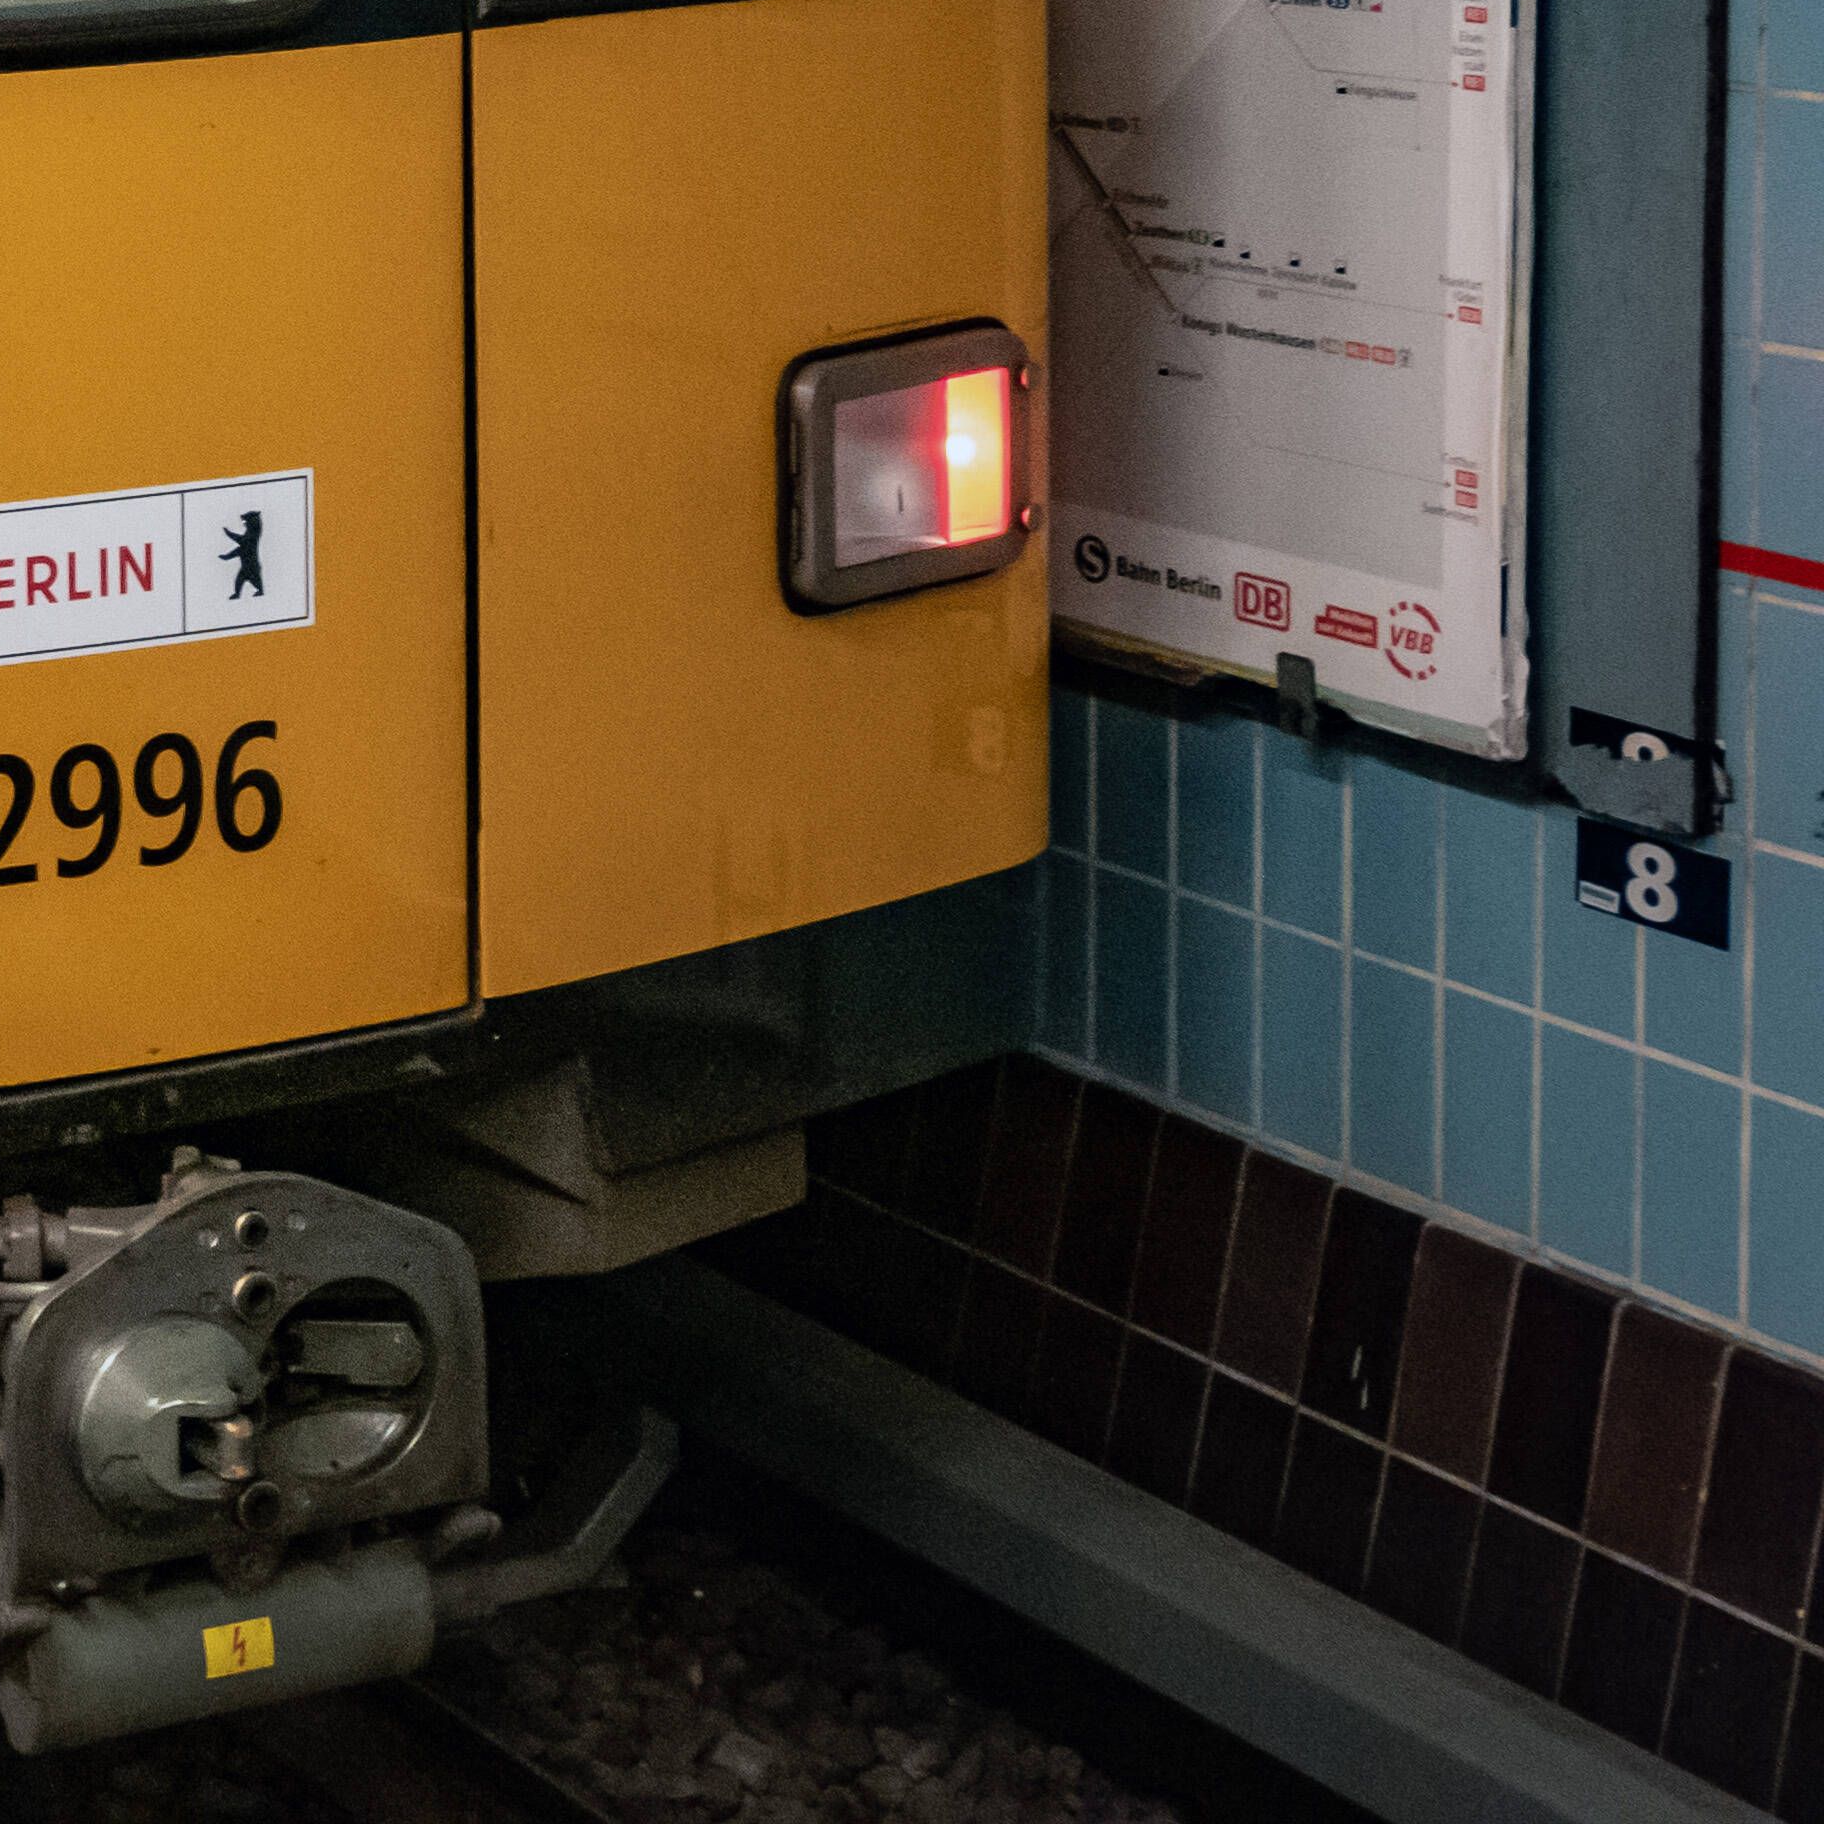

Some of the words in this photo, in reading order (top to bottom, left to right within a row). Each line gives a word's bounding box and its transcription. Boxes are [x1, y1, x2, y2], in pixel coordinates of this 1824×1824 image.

[1116, 555, 1161, 587] Bahn
[1167, 568, 1222, 601] Berlin
[1242, 586, 1284, 621] DB
[1389, 624, 1435, 655] VBB
[1625, 842, 1679, 923] 8
